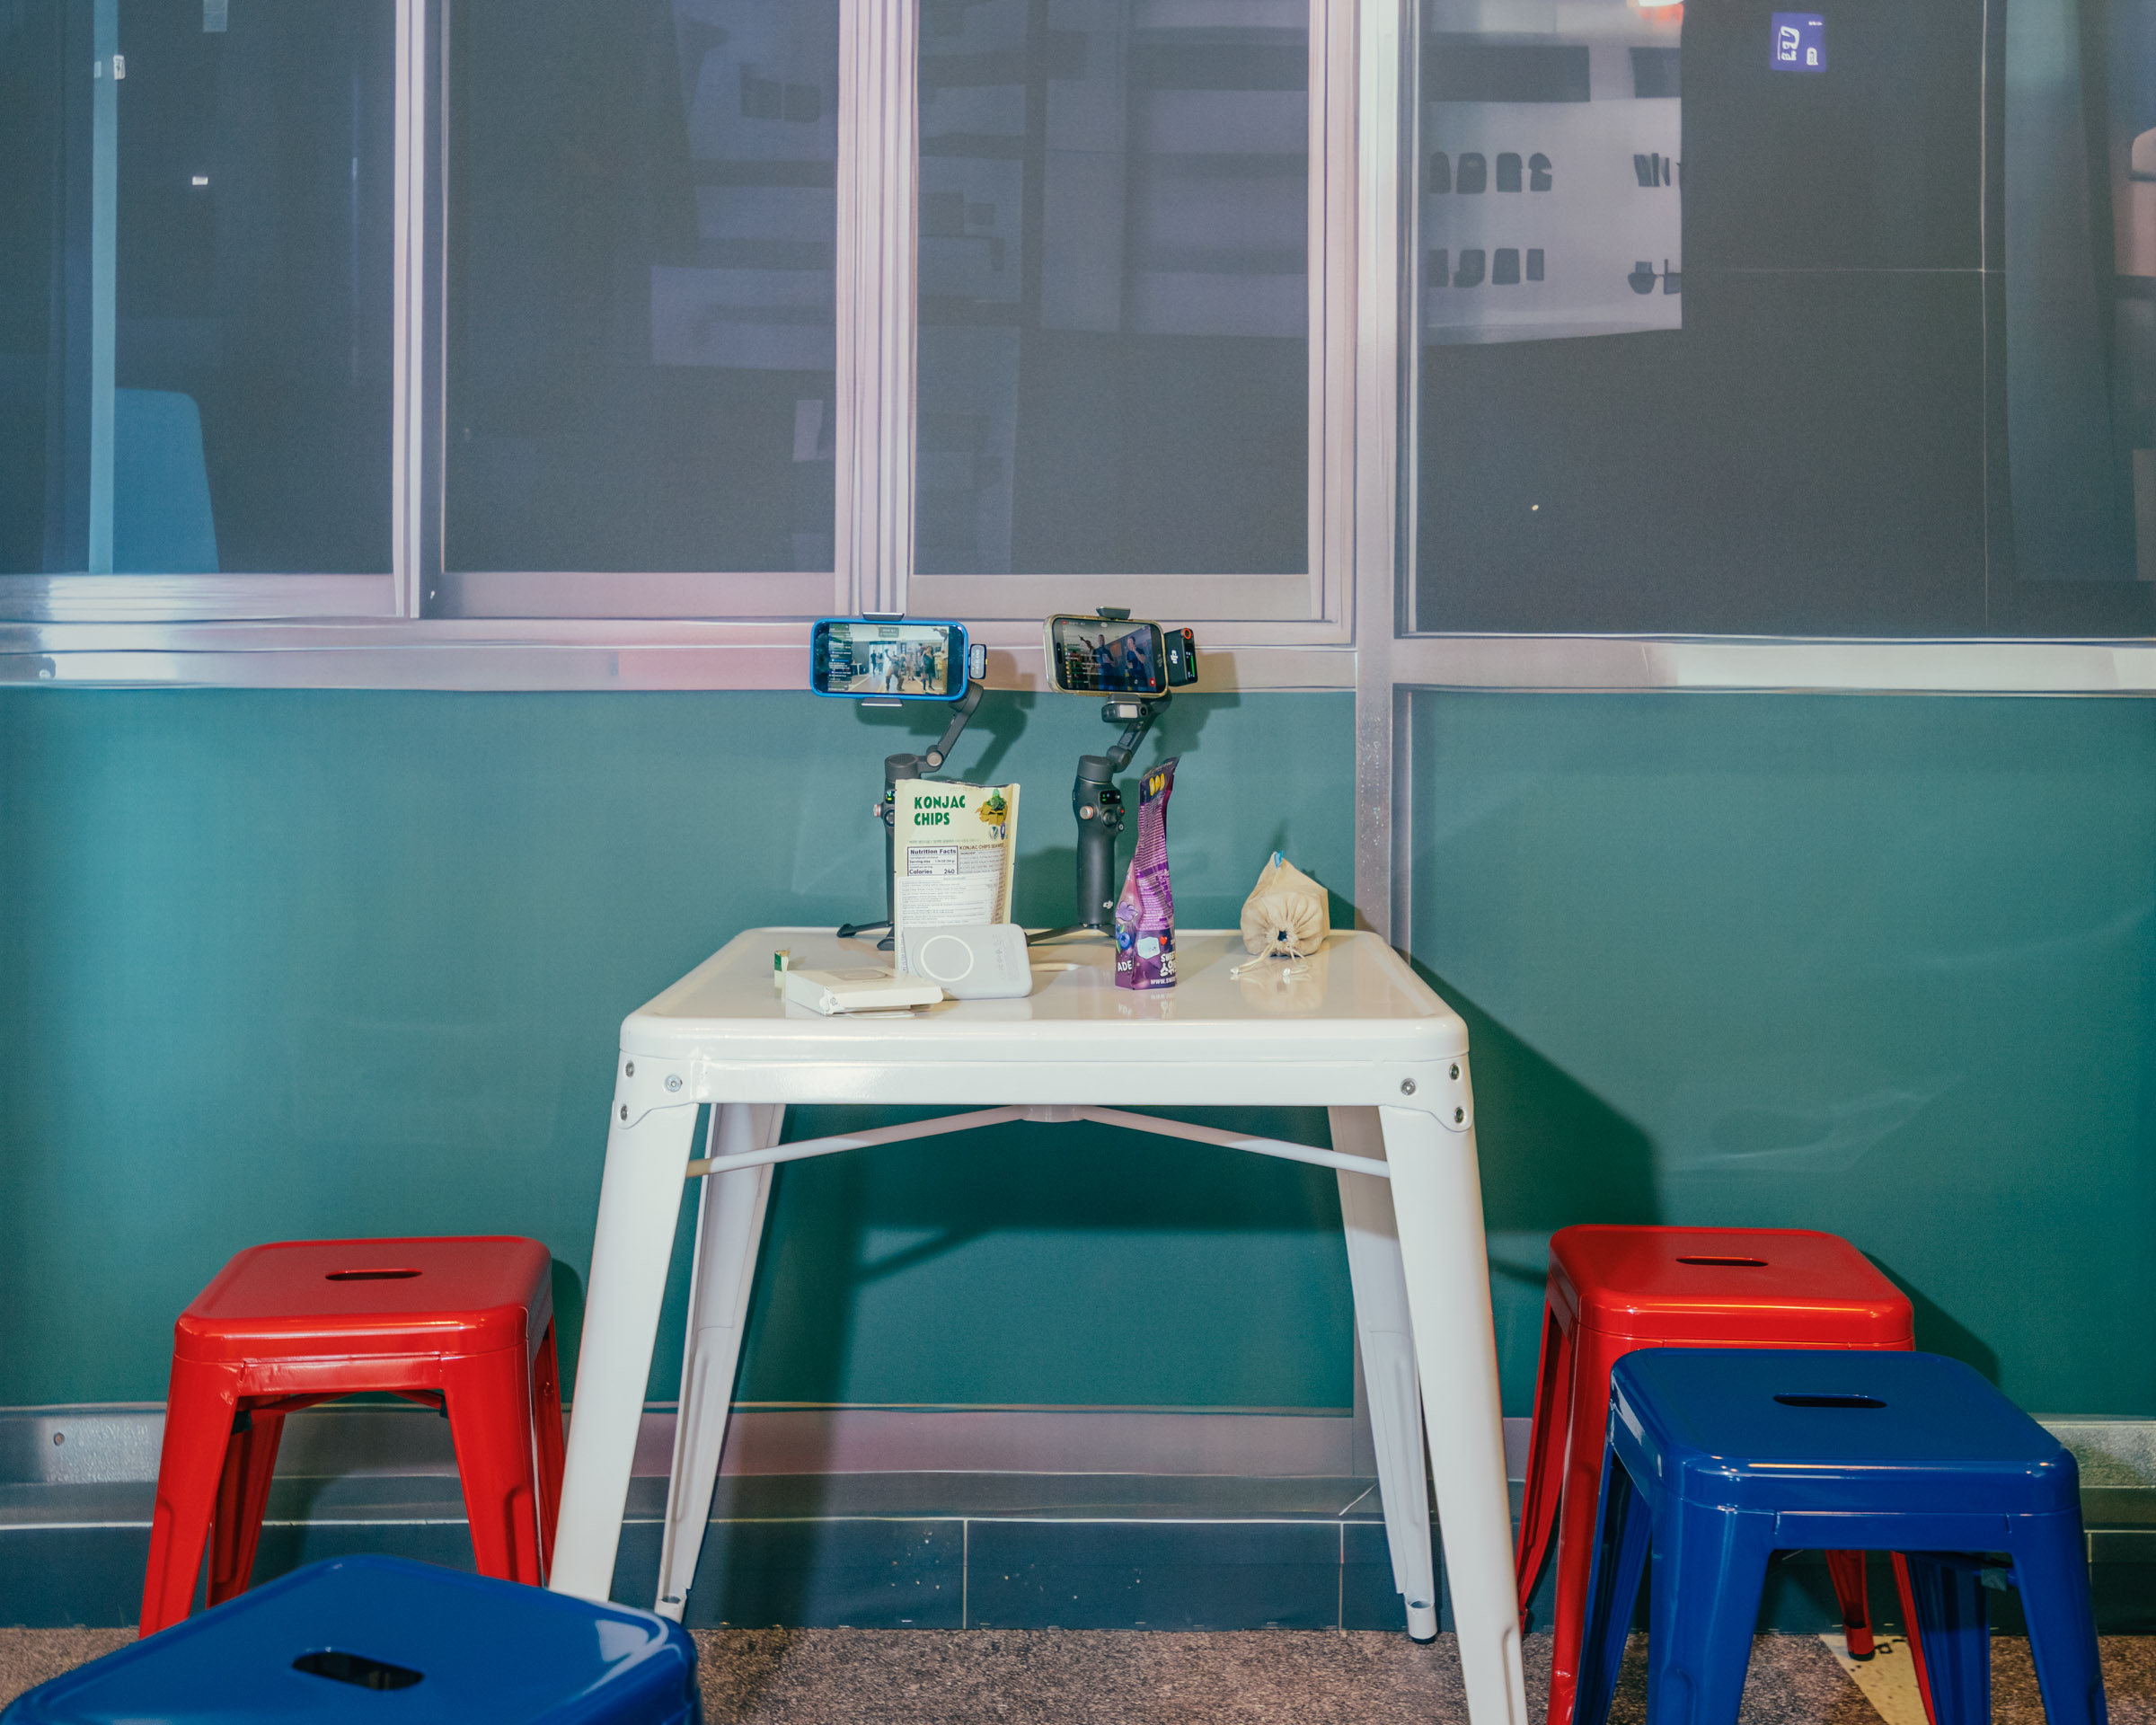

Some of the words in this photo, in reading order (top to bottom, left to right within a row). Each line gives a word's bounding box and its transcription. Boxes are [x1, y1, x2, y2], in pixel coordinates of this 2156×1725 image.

[914, 795, 966, 809] KONJAC
[914, 812, 950, 826] CHIPS
[1118, 960, 1133, 972] ADE
